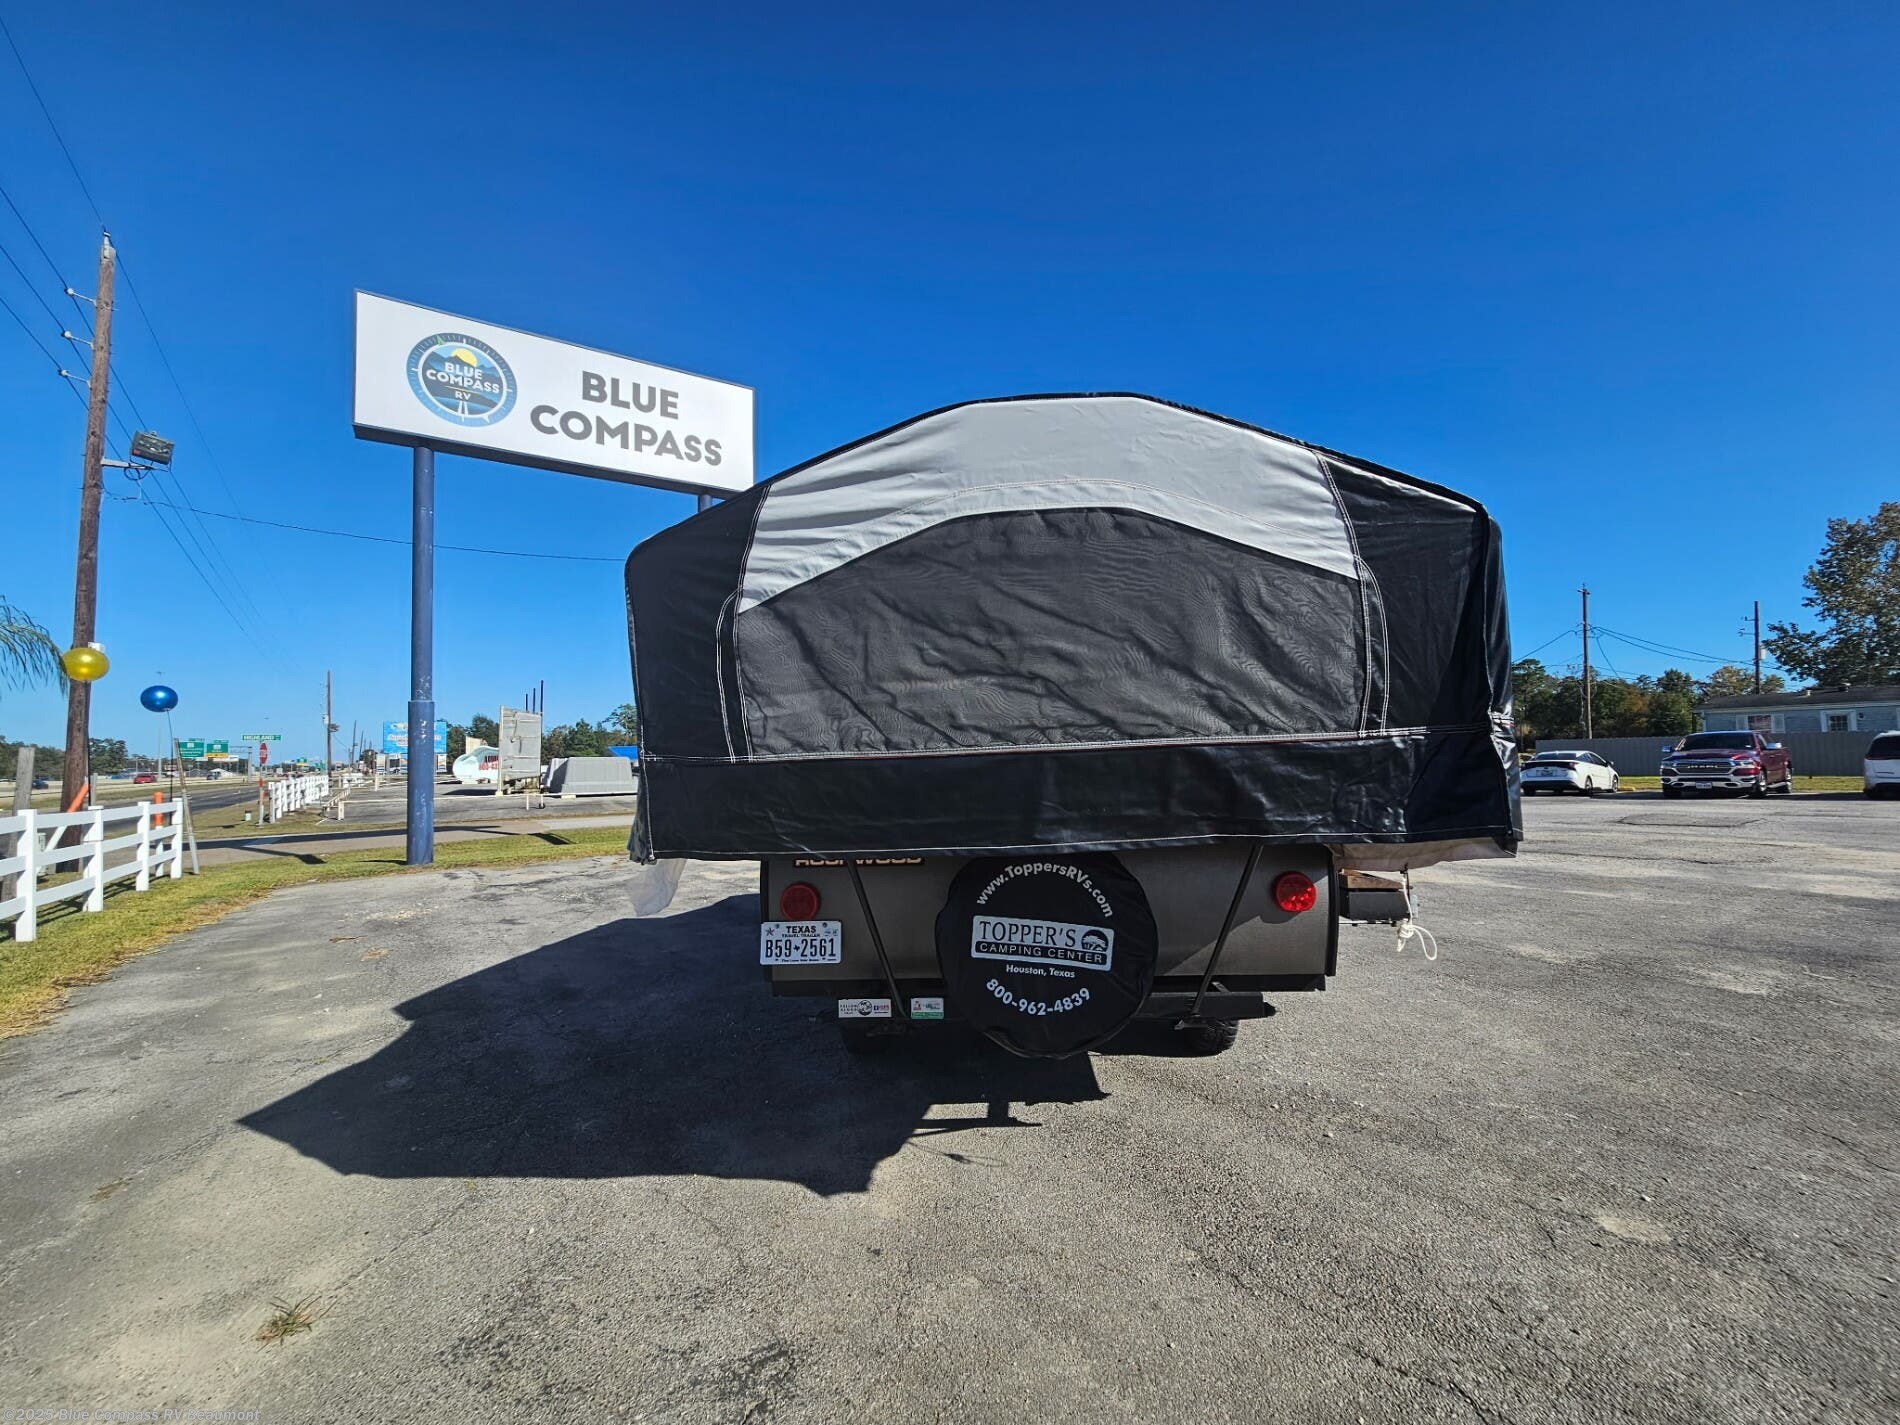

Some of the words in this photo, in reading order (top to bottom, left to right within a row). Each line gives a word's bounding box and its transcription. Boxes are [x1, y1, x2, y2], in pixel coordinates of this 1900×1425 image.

[426, 369, 500, 394] COMPASS
[445, 362, 483, 380] BLUE
[455, 391, 471, 401] RV
[581, 370, 679, 420] BLUE
[530, 404, 723, 466] COMPASS
[976, 862, 1113, 918] www.ToppersRVs.com
[786, 925, 817, 934] TEXAS
[979, 920, 1077, 948] TOPPER'S
[980, 942, 1042, 956] CAMPING
[1047, 948, 1102, 963] CENTER
[1006, 964, 1047, 976] Houston,
[1049, 967, 1076, 978] Texas
[986, 978, 1090, 1016] 800-962-4839
